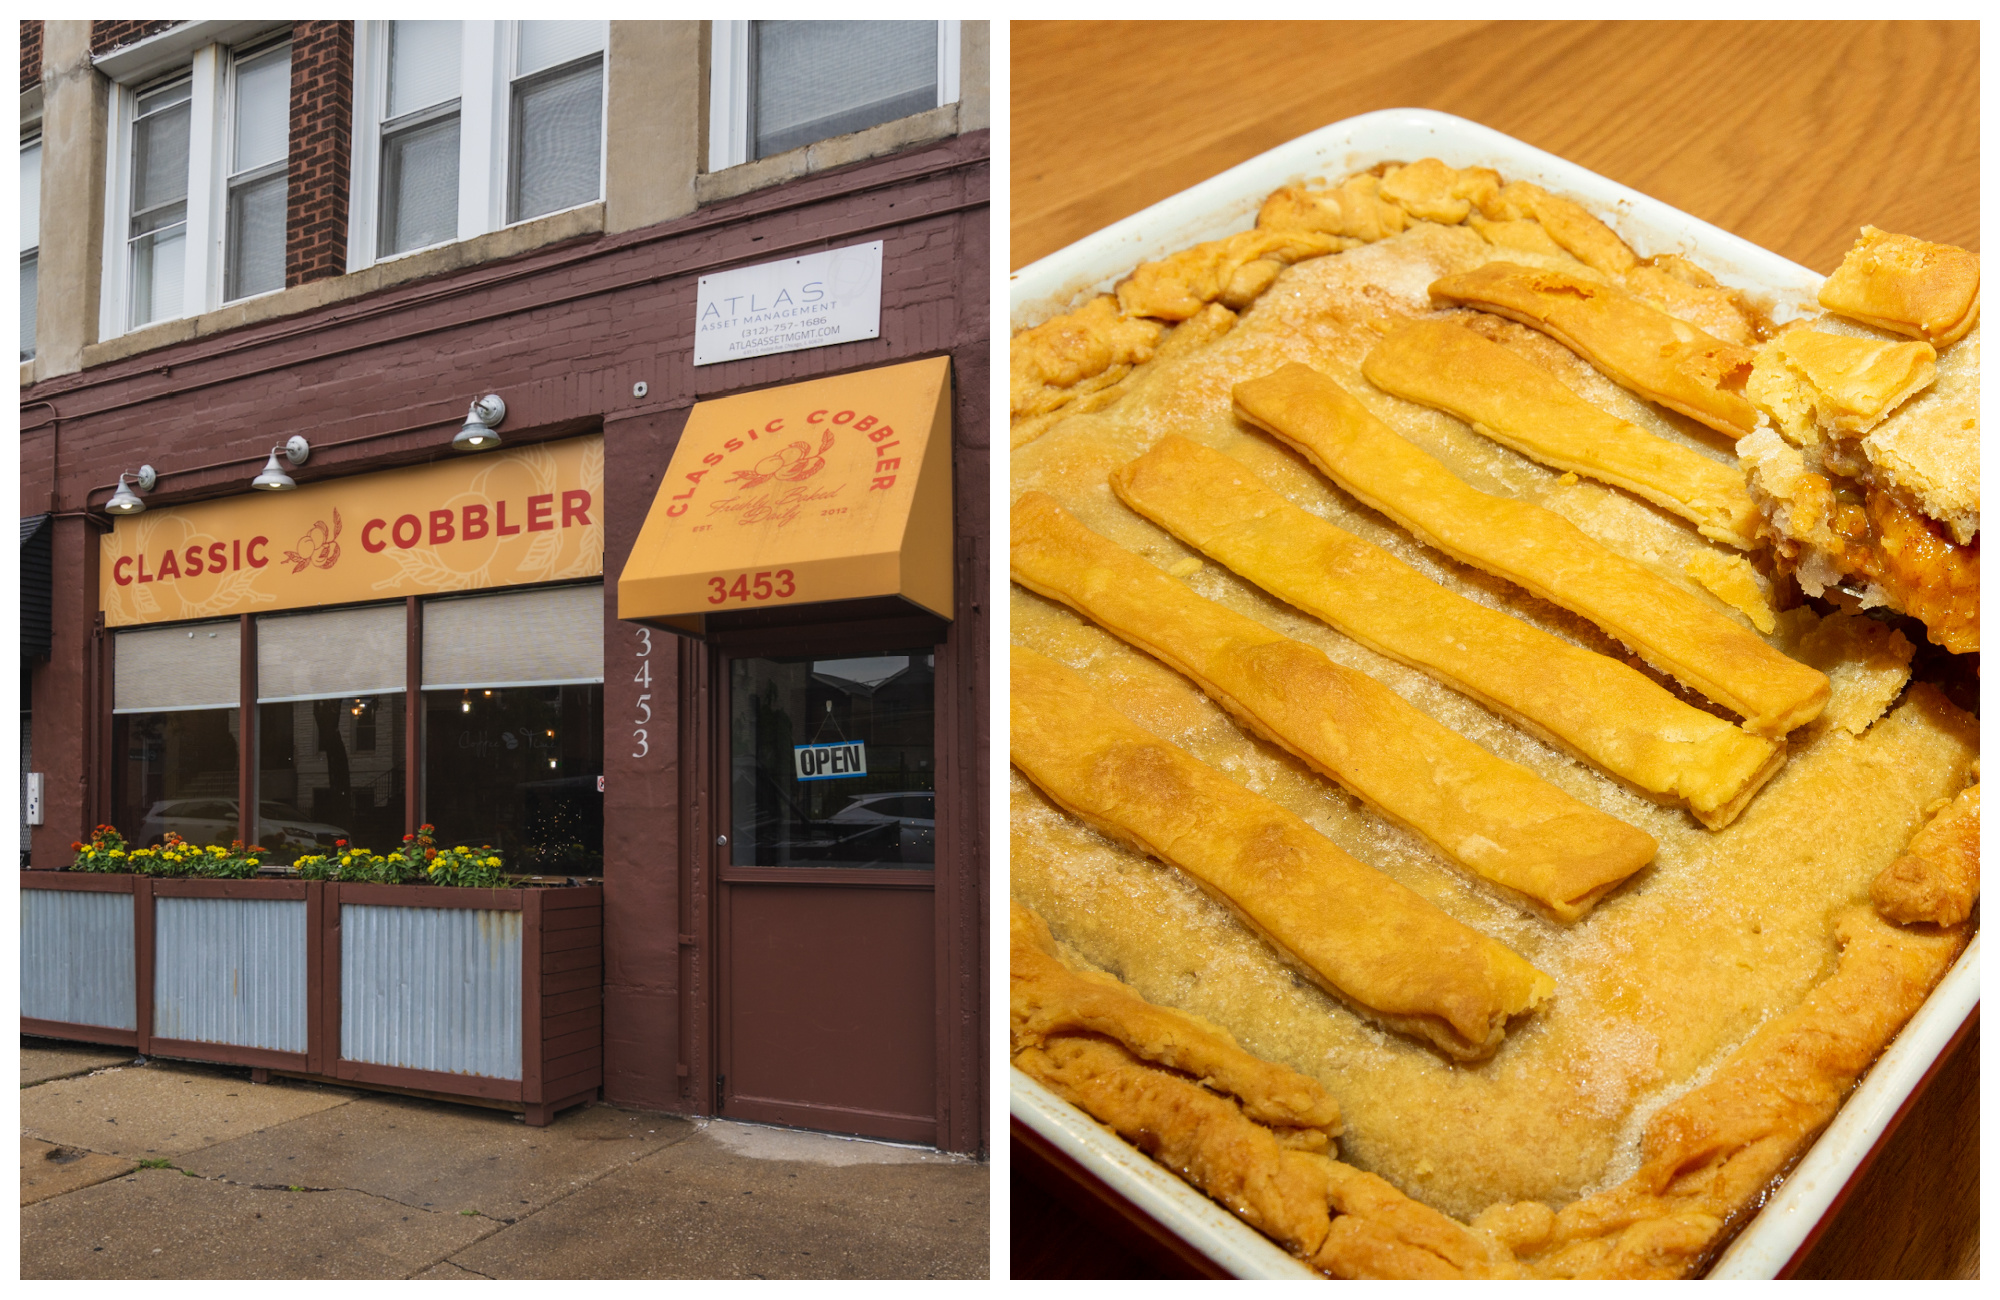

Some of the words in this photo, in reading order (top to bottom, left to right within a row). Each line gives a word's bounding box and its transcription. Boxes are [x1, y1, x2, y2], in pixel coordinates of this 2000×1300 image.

[701, 282, 824, 321] ATLAS
[701, 318, 739, 332] ASSET
[743, 301, 838, 324] MANAGEMENT
[728, 325, 841, 351] ATLASASSETMGMT.COM
[741, 316, 827, 338] (312)-757-1686
[666, 418, 785, 518] CLASSIC
[806, 410, 902, 492] COBBLER
[706, 493, 770, 517] Freshly
[775, 483, 847, 506] Baked
[738, 504, 801, 528] Daily
[692, 524, 714, 533] EST.
[820, 507, 848, 517] 2012
[113, 535, 269, 586] CLASSIC
[361, 489, 592, 554] COBBLER
[707, 569, 796, 605] 3453
[631, 628, 653, 758] 3453
[800, 745, 861, 776] OPEN
